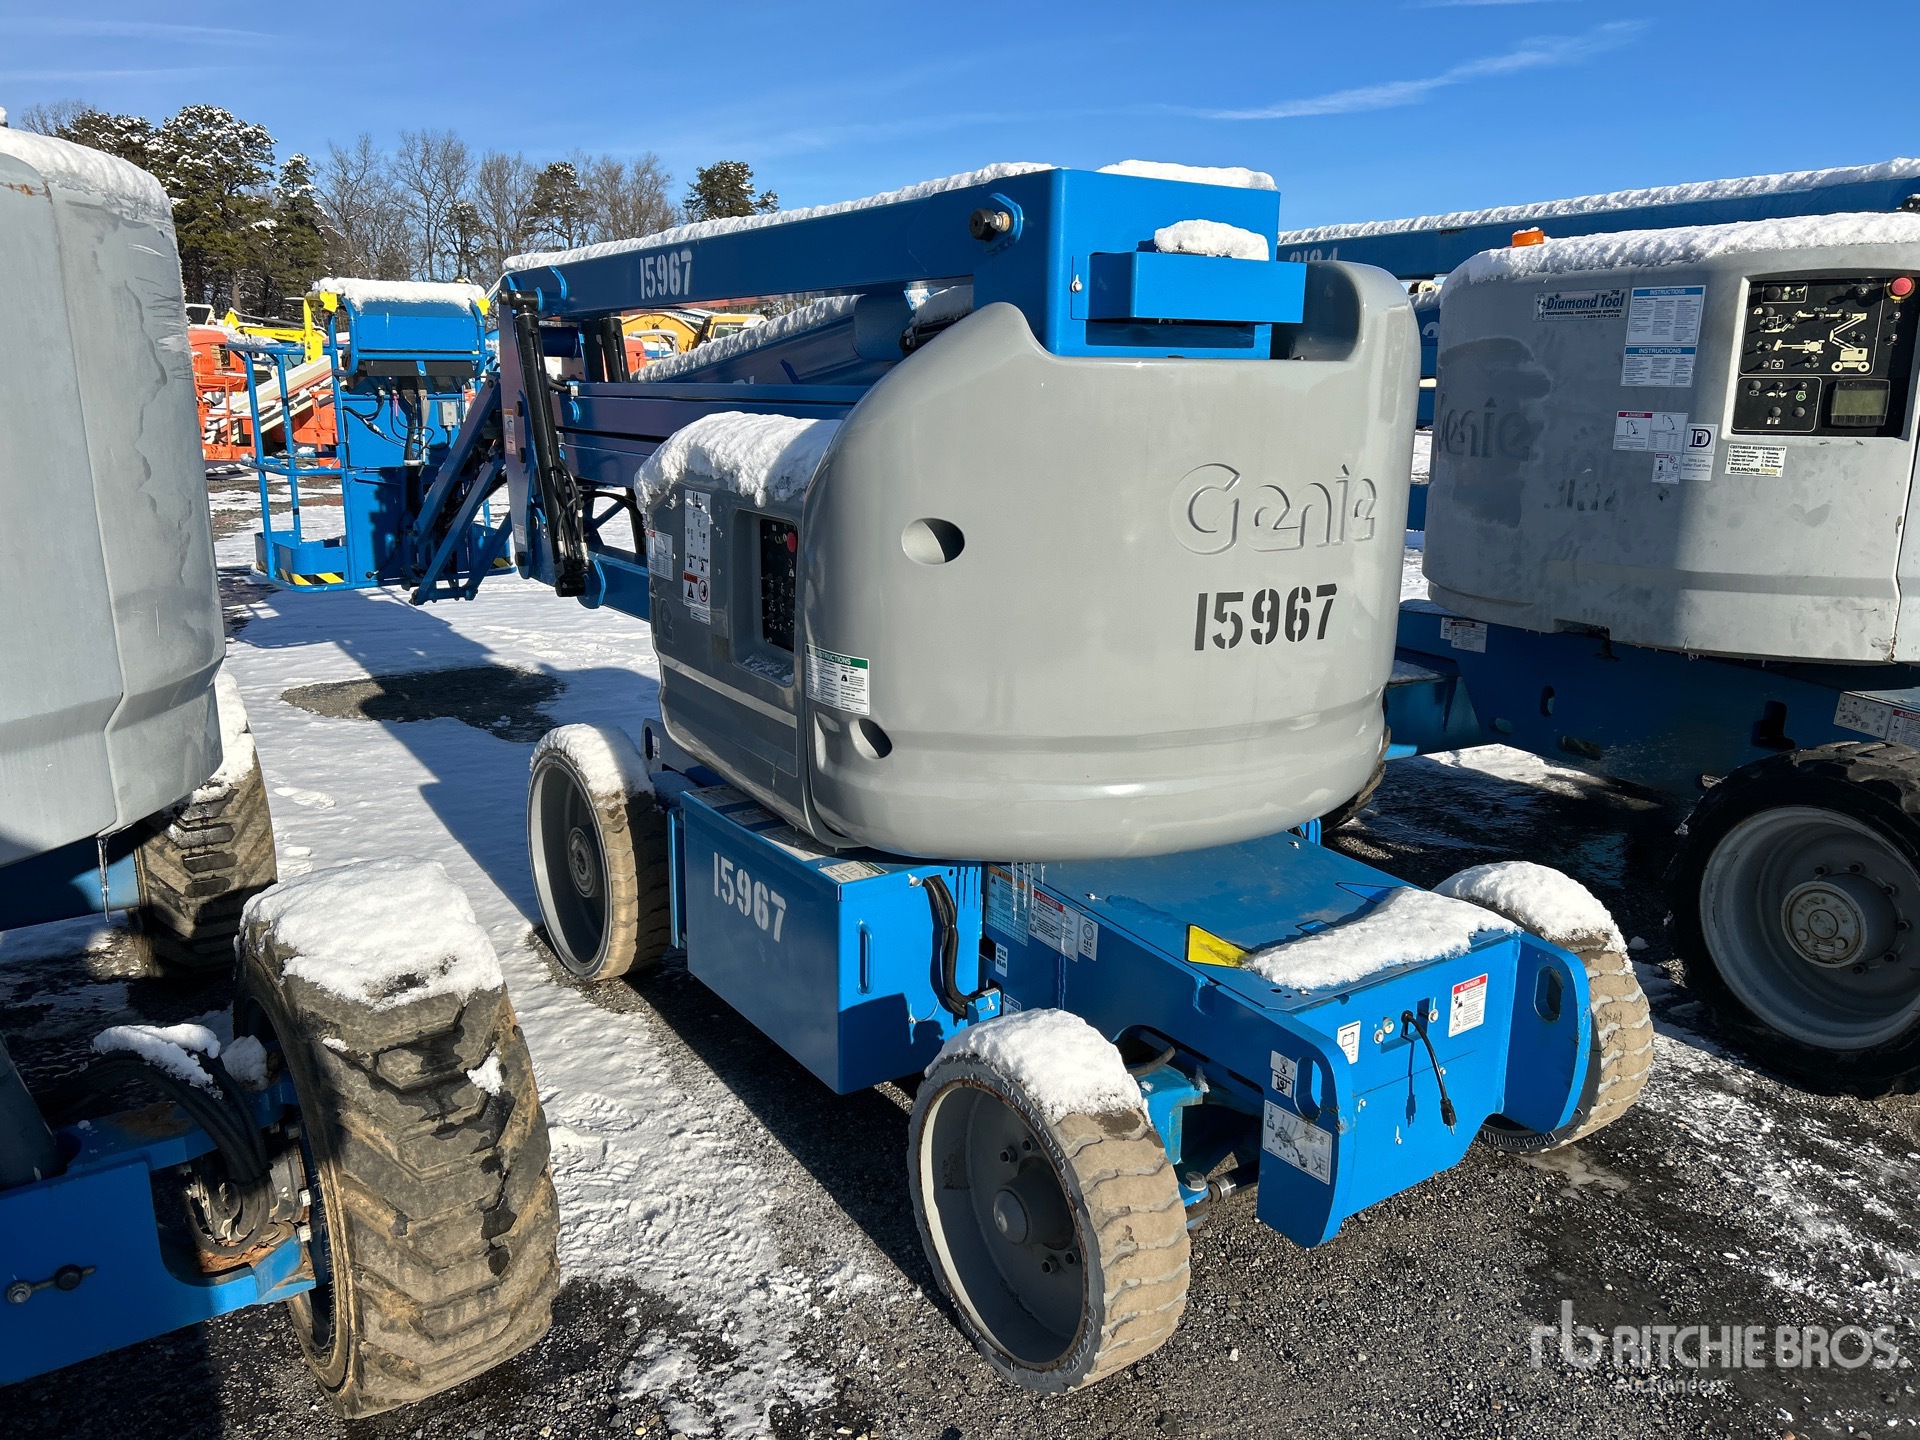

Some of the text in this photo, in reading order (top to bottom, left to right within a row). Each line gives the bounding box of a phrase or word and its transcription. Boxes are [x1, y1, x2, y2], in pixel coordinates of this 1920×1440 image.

[639, 248, 692, 299] 15967
[1546, 293, 1624, 310] Diamond Tool
[1689, 428, 1711, 448] D
[1169, 463, 1377, 555] Genie
[1195, 583, 1338, 651] 15967
[713, 851, 787, 943] 15967
